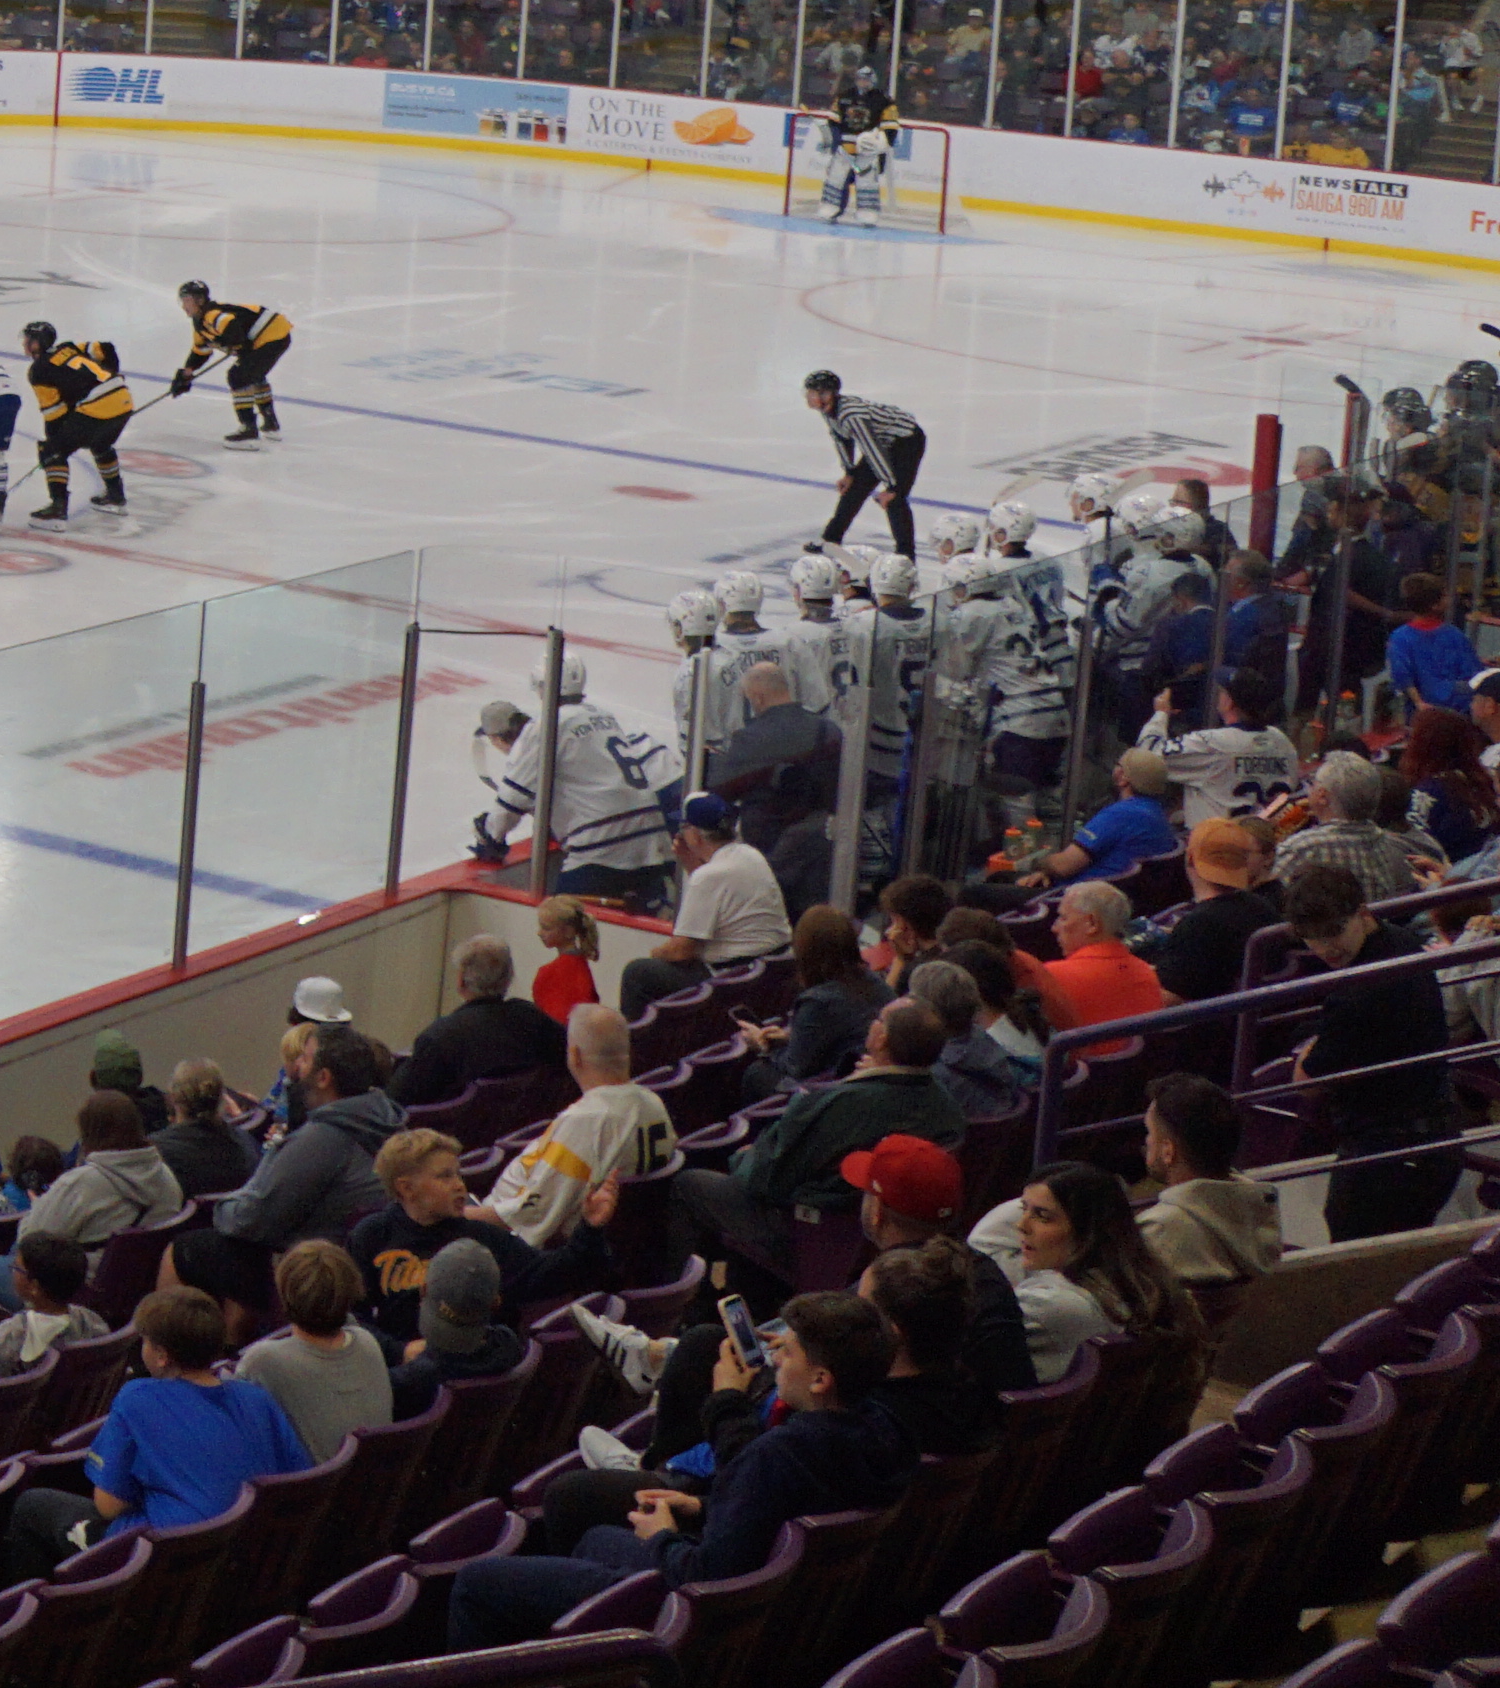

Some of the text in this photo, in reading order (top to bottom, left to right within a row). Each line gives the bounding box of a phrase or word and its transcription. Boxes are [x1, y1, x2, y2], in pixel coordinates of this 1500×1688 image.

[68, 66, 164, 105] OHL
[589, 96, 666, 118] ON THE
[587, 115, 666, 142] MOVE
[1299, 175, 1408, 198] NEWS TALK
[1296, 190, 1405, 221] SAUGA 960 AM
